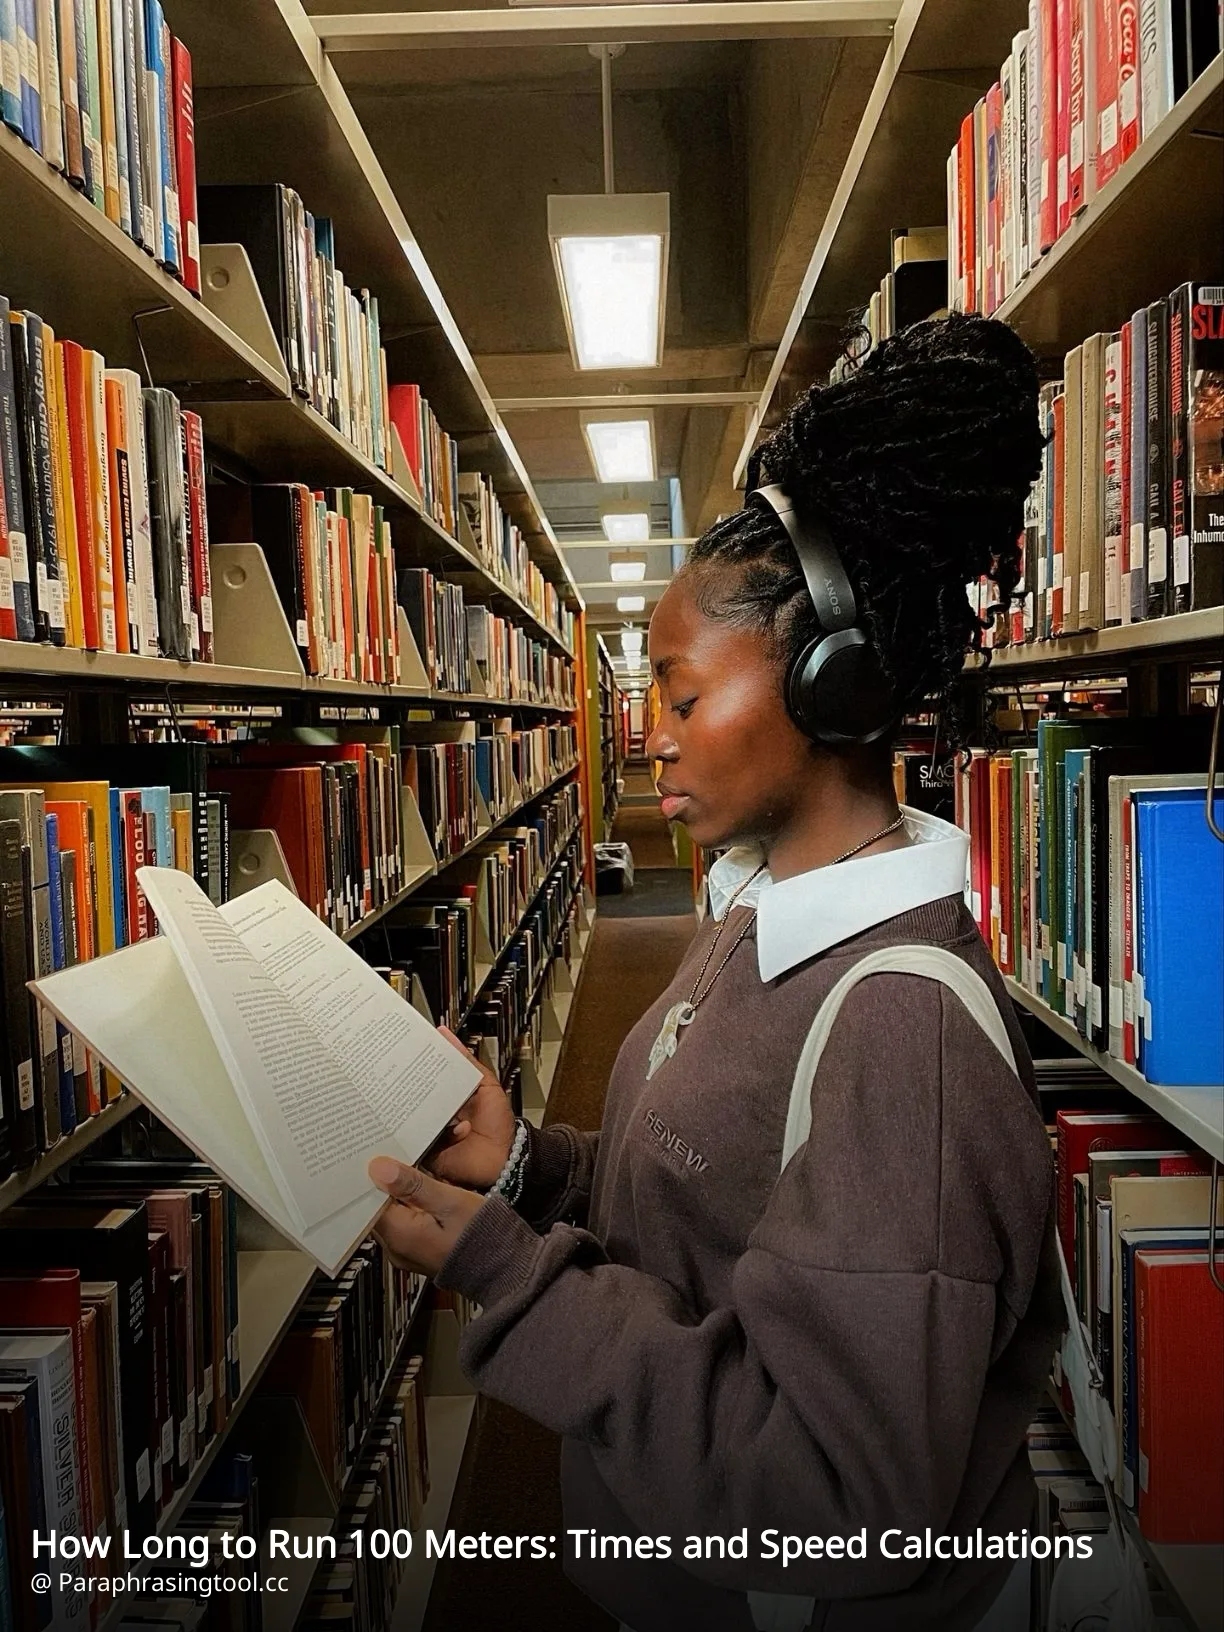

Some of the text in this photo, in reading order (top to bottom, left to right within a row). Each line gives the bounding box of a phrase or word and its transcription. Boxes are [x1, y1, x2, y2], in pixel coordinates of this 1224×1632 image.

[33, 336, 45, 401] Energy
[1147, 321, 1159, 423] SLAUGHTERHOUSE
[1171, 312, 1182, 416] SLAUGHTERHOUSE
[126, 538, 134, 585] Growin
[823, 578, 841, 616] SONY
